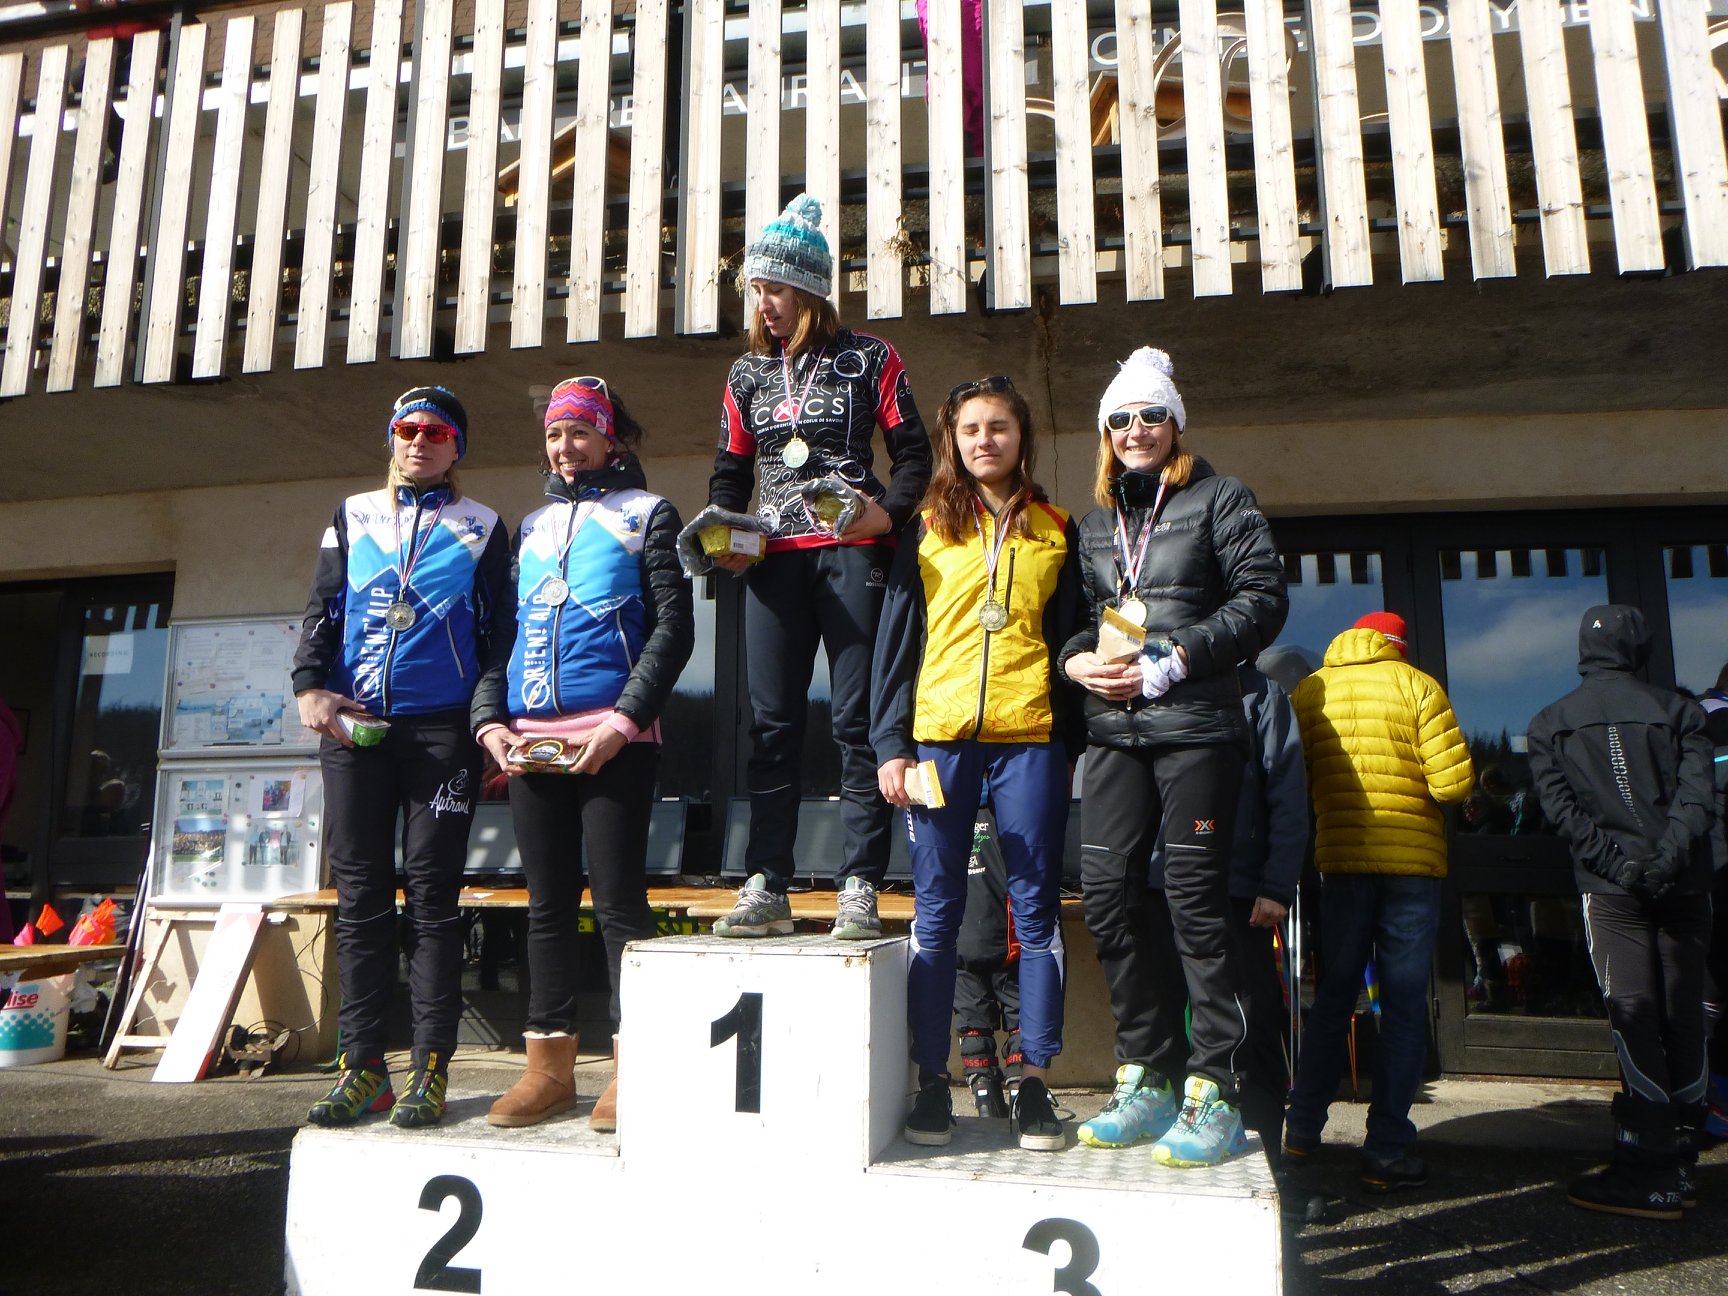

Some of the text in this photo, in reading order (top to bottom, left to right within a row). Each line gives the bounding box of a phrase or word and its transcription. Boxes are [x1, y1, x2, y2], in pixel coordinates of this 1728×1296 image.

[710, 993, 762, 1113] 1
[414, 1175, 482, 1294] 2
[1022, 1218, 1101, 1296] 3
